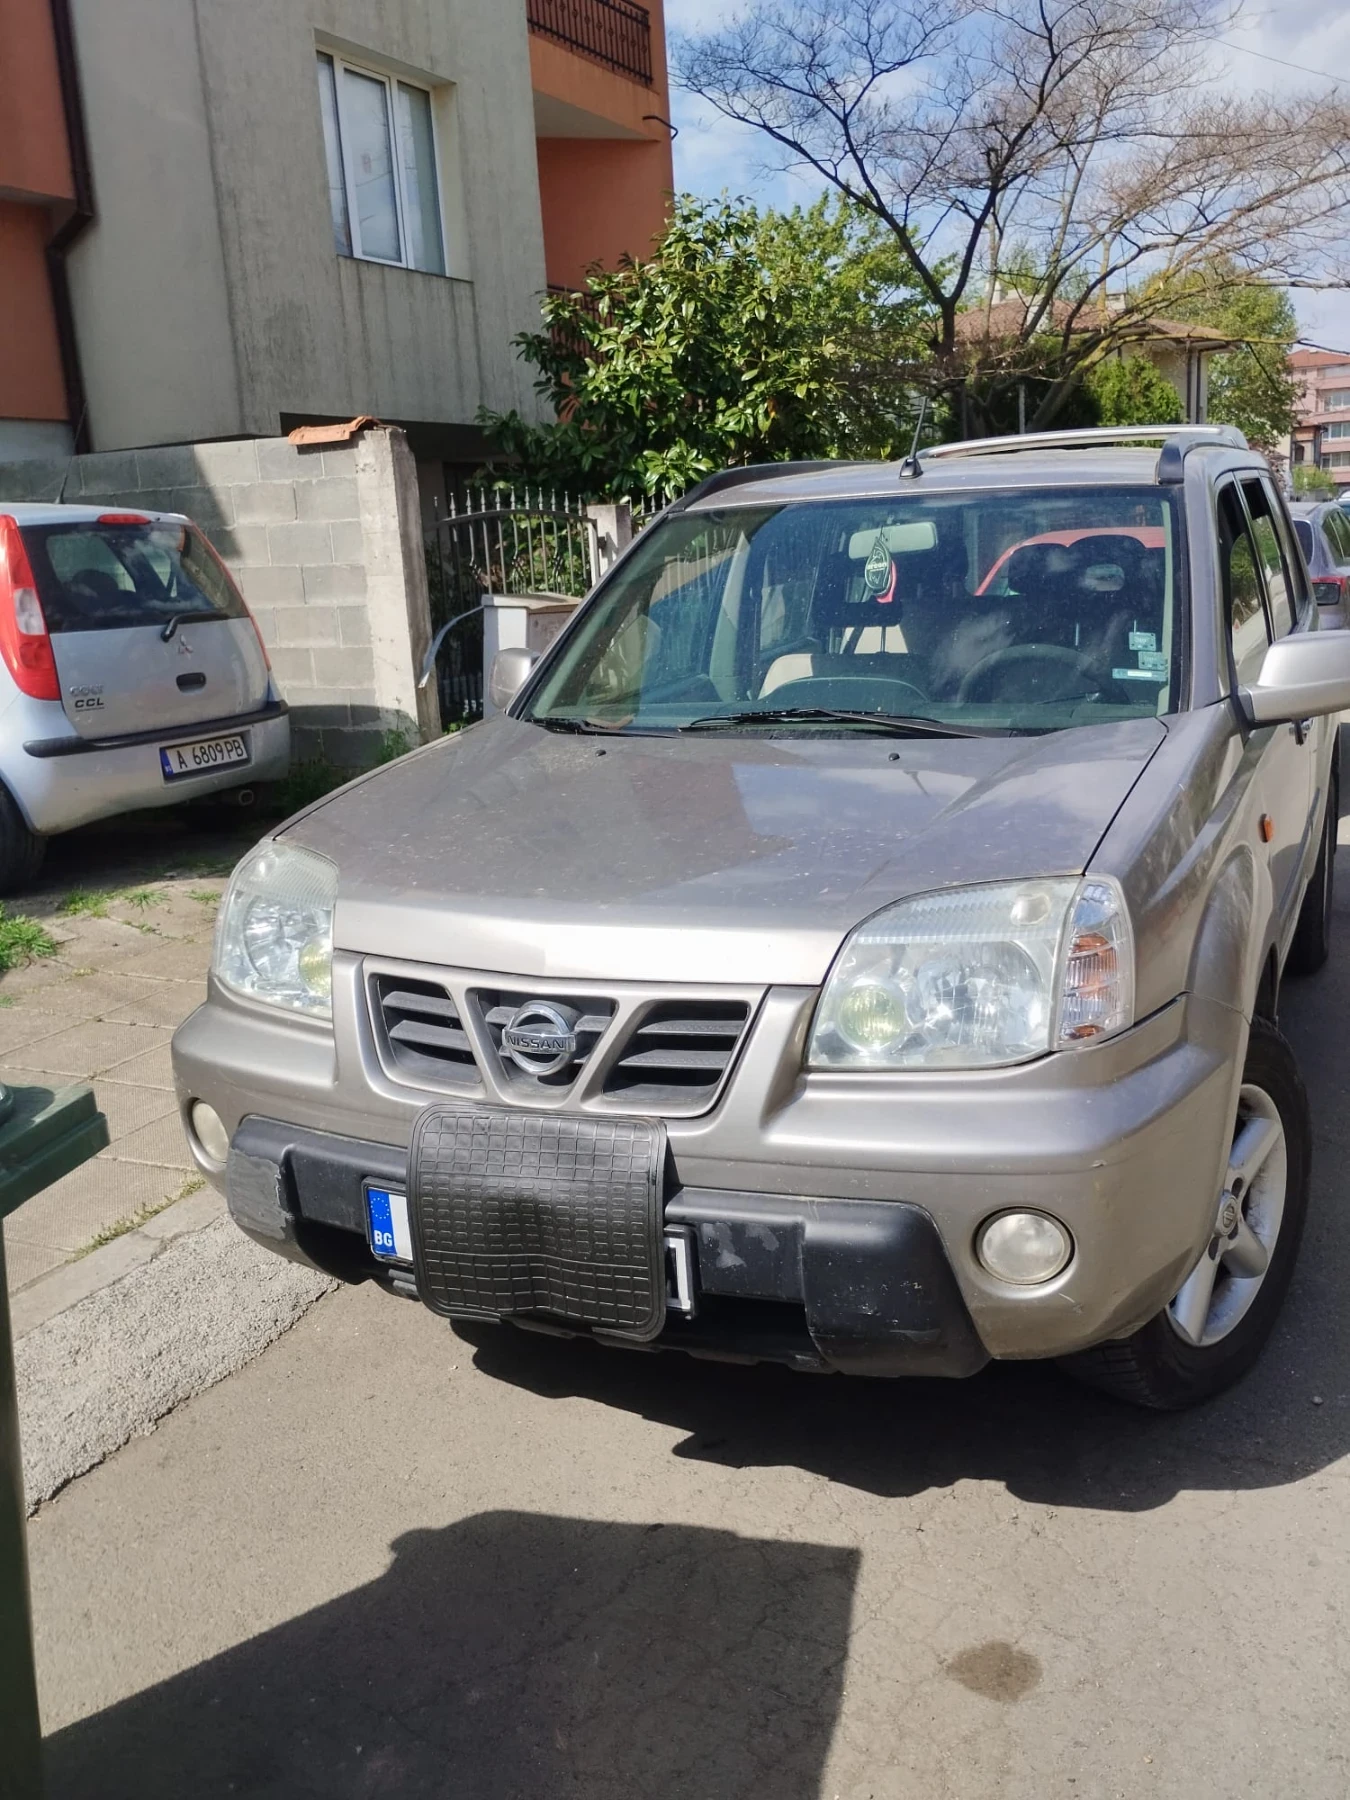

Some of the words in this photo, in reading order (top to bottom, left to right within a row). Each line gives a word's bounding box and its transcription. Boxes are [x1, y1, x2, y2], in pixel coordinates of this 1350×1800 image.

[70, 684, 104, 697] COLT
[75, 697, 105, 708] CCL
[176, 750, 188, 769] A
[507, 1035, 564, 1049] NISSAN
[373, 1229, 393, 1247] BG
